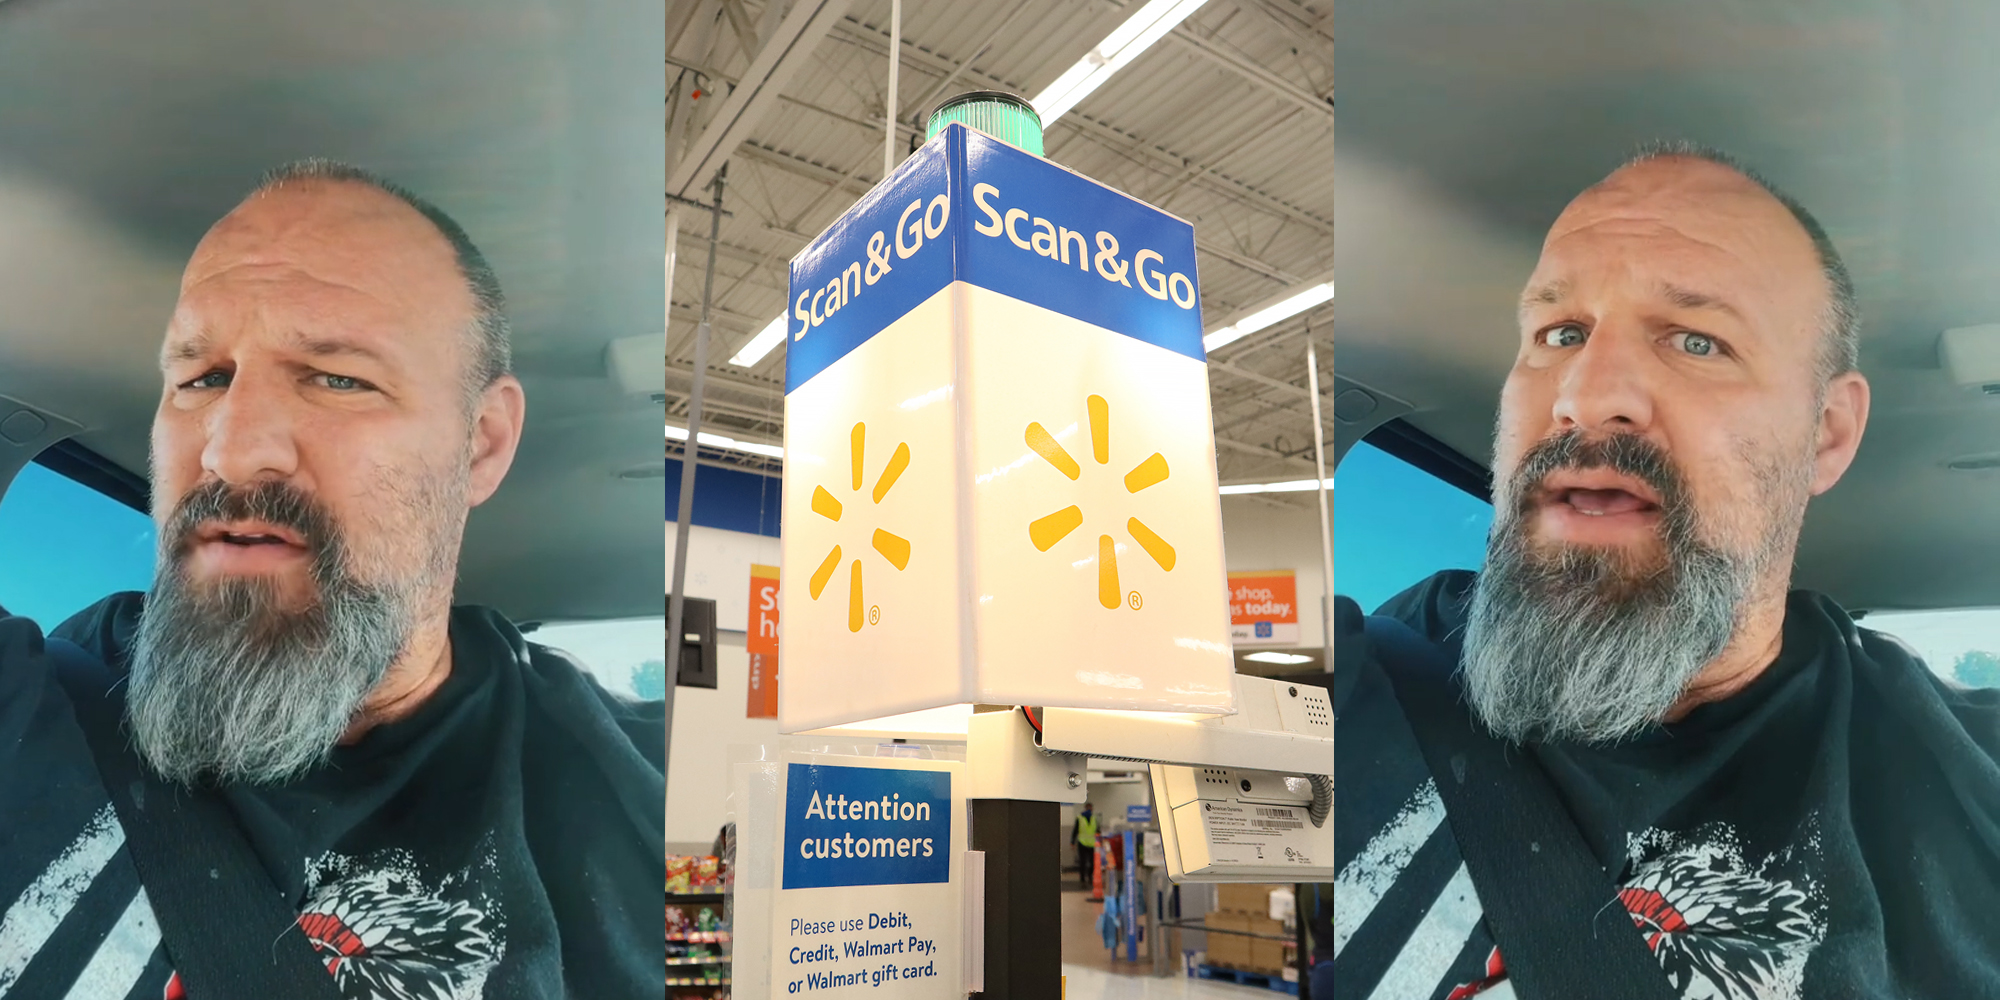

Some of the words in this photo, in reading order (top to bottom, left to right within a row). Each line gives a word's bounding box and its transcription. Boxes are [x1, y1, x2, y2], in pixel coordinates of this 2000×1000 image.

[1235, 585, 1275, 603] shop.
[1244, 600, 1293, 618] today.
[804, 789, 931, 821] Attention
[800, 832, 934, 860] customers
[790, 918, 836, 936] Please
[839, 918, 864, 932] use
[868, 911, 912, 930] Debit,
[789, 944, 839, 965] Credit,
[843, 939, 904, 959] Walmart
[908, 936, 937, 956] Pay,
[788, 979, 804, 994] or
[807, 968, 868, 991] Walmart
[871, 963, 899, 987] gift
[902, 960, 938, 979] card.
